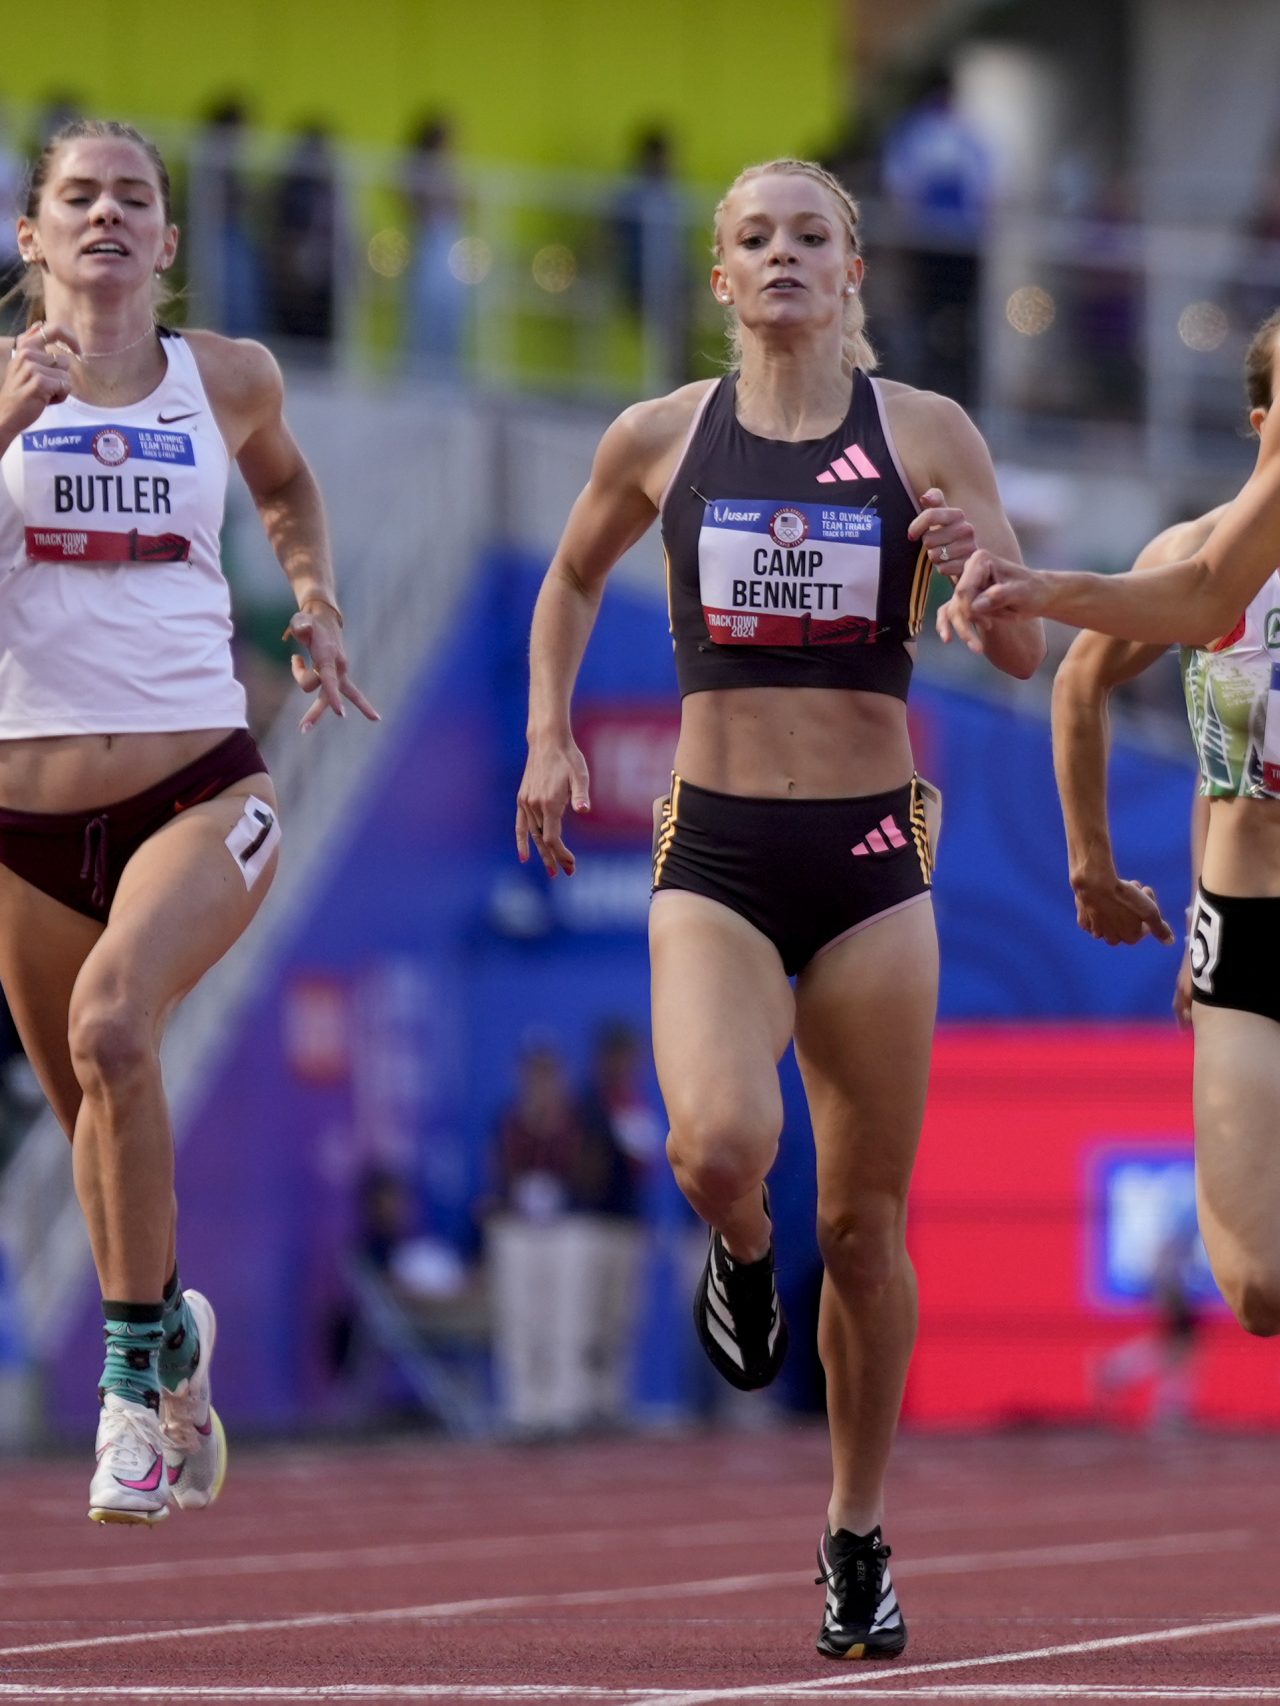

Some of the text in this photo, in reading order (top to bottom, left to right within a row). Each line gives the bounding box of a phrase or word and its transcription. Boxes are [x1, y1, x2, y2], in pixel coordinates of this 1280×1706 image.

[48, 435, 82, 446] USATF
[153, 433, 184, 443] OLYMPIC
[140, 441, 185, 453] TEAM TRIALS
[54, 475, 171, 514] BUTLER
[728, 512, 761, 521] USATF
[822, 511, 872, 523] U.S. OLYMPIC
[822, 520, 872, 531] TEAM TRIALS
[62, 544, 85, 555] 2024
[753, 548, 823, 577] CAMP
[732, 579, 843, 610] BENNETT
[731, 626, 755, 637] 2024
[239, 807, 274, 868] 7
[1190, 903, 1212, 979] 5
